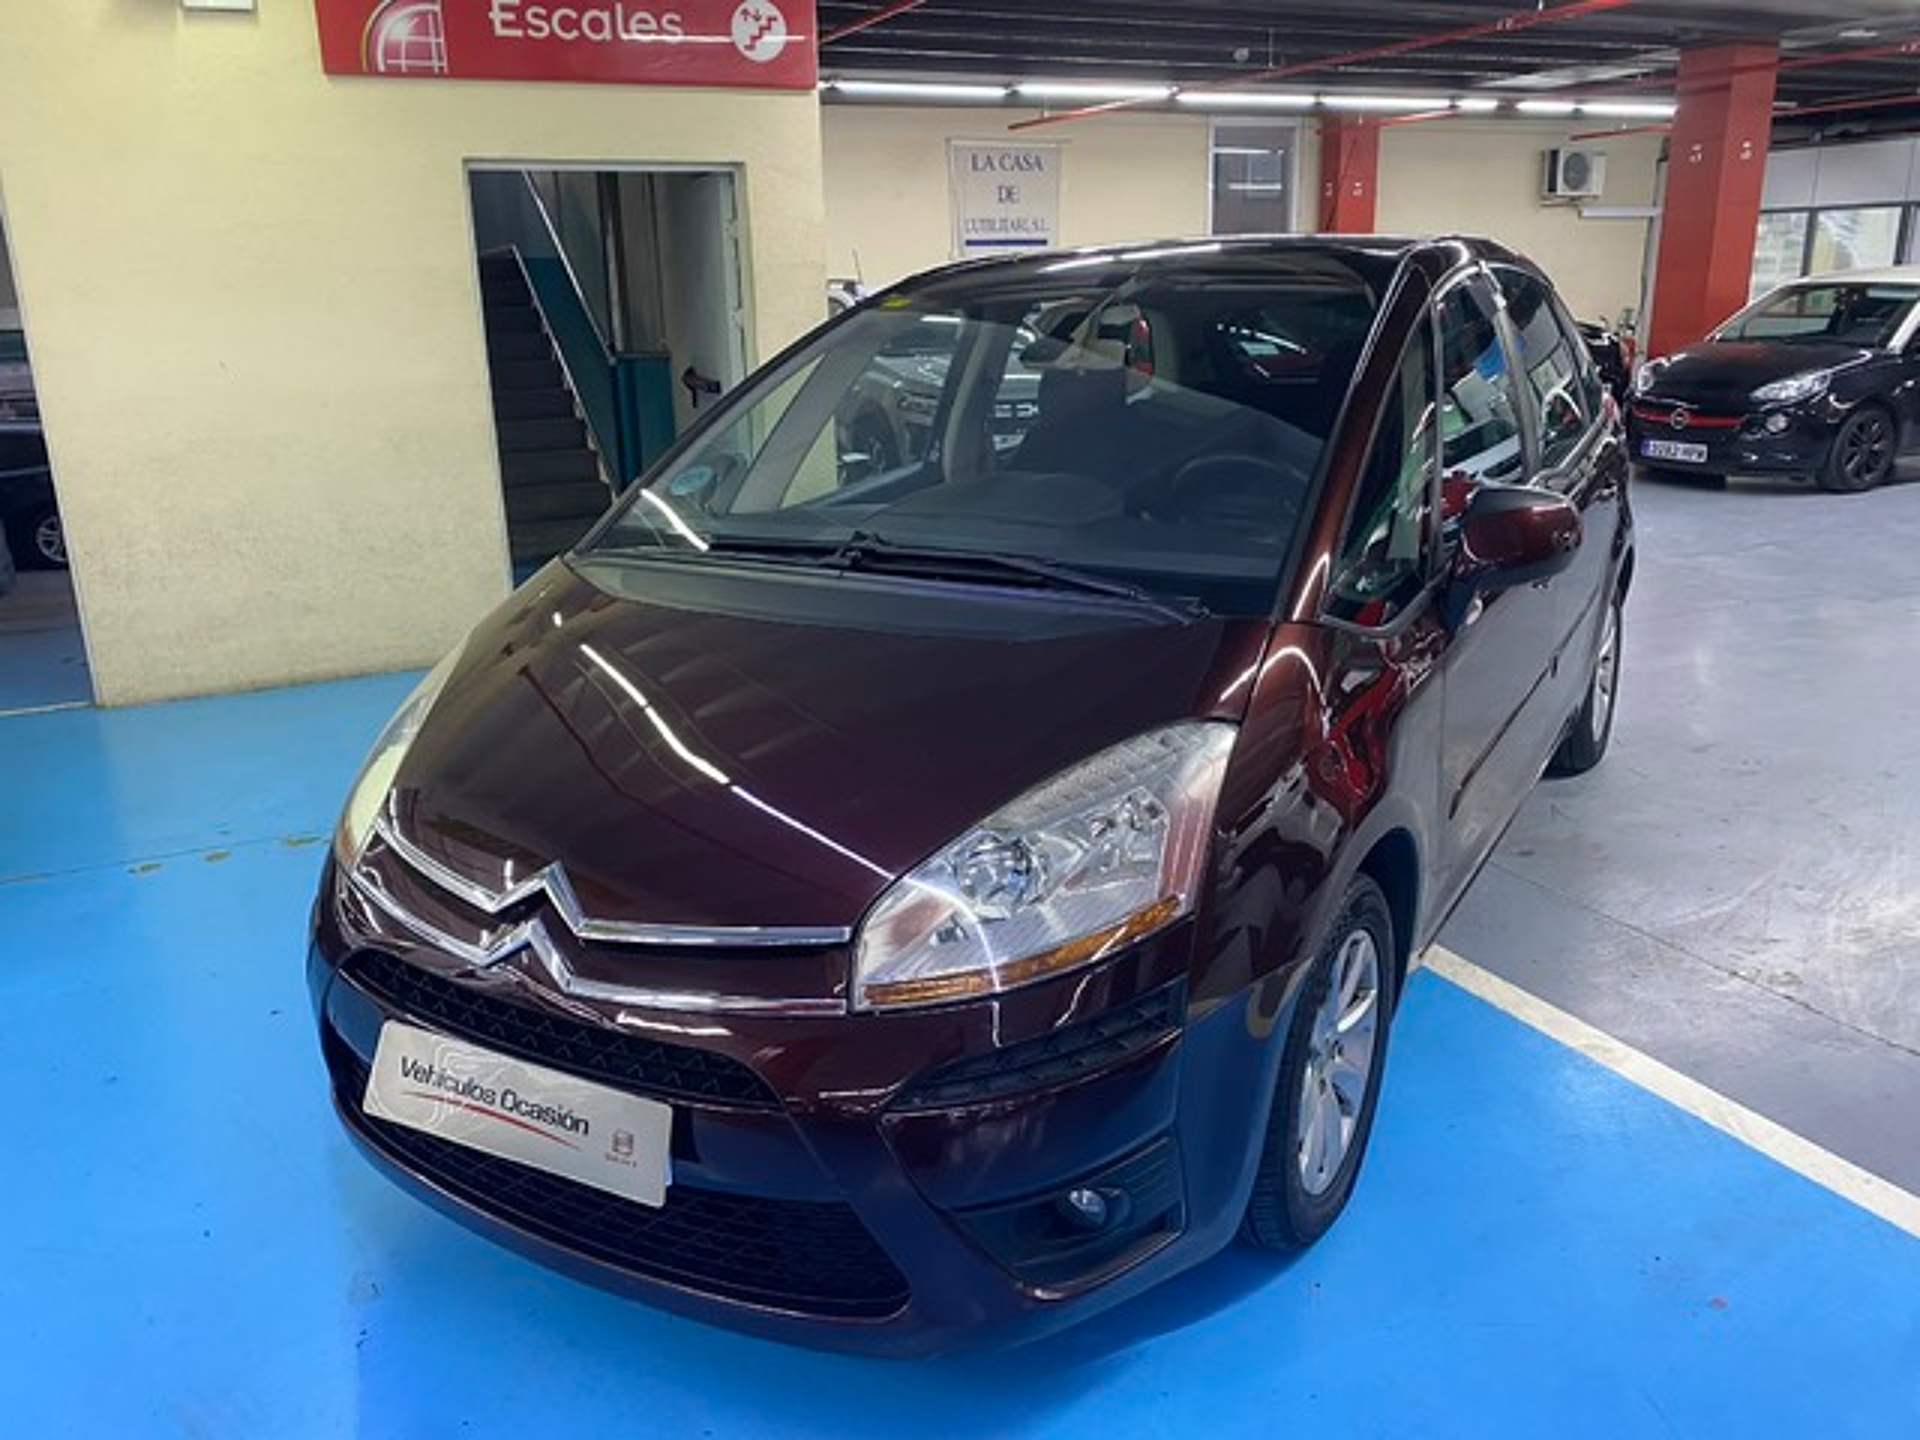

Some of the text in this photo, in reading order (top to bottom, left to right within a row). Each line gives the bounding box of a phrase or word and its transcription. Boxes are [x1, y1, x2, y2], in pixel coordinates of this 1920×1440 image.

[488, 0, 684, 43] Escales
[970, 152, 1045, 172] LA CASA
[997, 184, 1020, 204] DE
[500, 1088, 589, 1135] Ocasión
